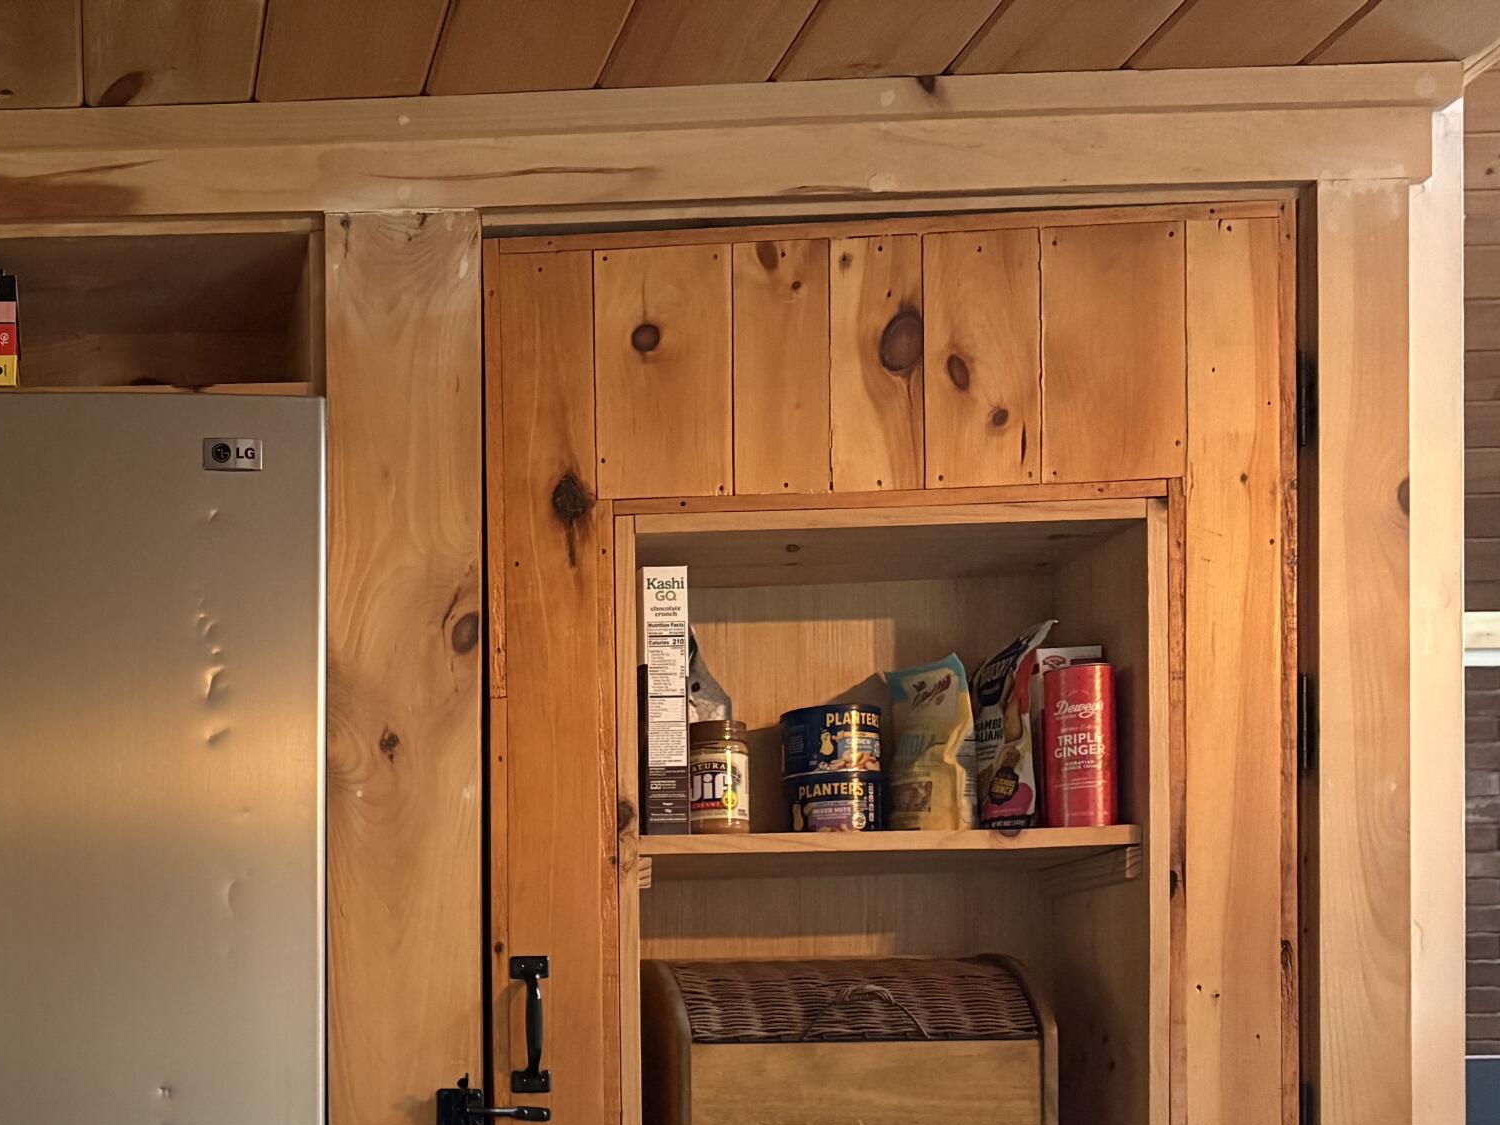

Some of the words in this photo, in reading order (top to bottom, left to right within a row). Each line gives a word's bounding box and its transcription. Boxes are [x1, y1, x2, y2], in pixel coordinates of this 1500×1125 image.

[235, 447, 256, 460] LG
[646, 577, 685, 590] Kashi
[655, 590, 676, 601] GO
[1054, 743, 1105, 758] GINGER
[690, 773, 732, 802] Jif
[798, 782, 864, 800] PLANTERS
